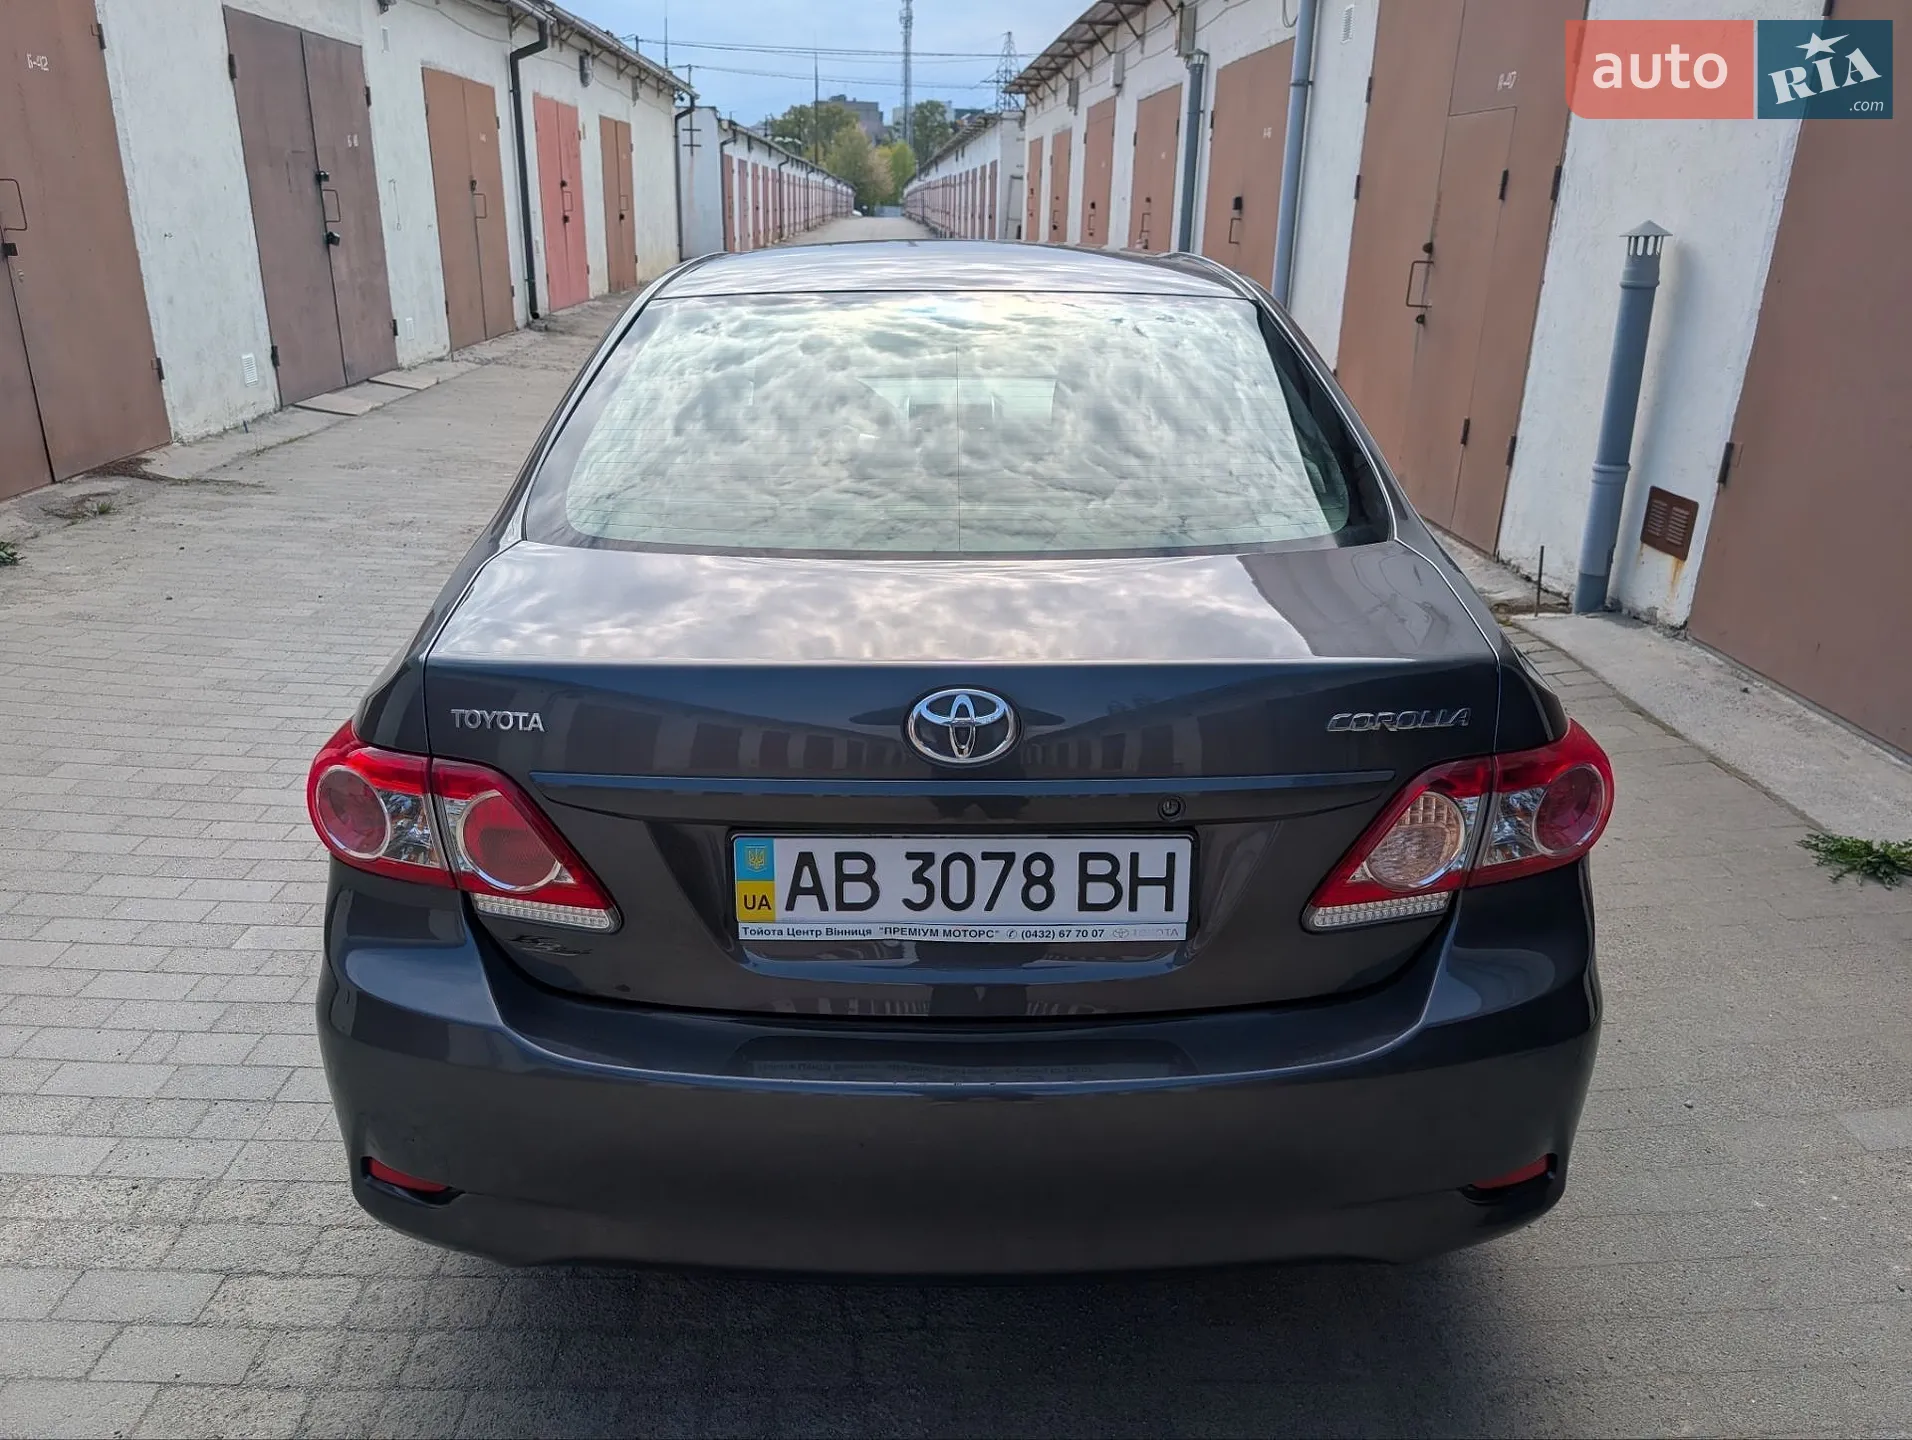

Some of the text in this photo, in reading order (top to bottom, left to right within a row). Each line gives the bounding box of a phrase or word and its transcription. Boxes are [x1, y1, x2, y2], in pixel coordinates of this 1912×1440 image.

[450, 708, 545, 733] TOYOTA
[1327, 707, 1472, 732] COROLLA
[784, 851, 1176, 912] AB 3078 BH
[743, 894, 772, 911] UA
[742, 926, 783, 937] Тойота
[786, 927, 823, 938] Центр
[825, 927, 873, 939] Вінниця
[879, 926, 939, 938] "ПРЕМІУМ
[942, 929, 999, 939] МОТОРС"
[1021, 930, 1056, 940] (0432)
[1058, 930, 1072, 939] 67
[1075, 930, 1089, 939] 70
[1091, 929, 1105, 939] 07
